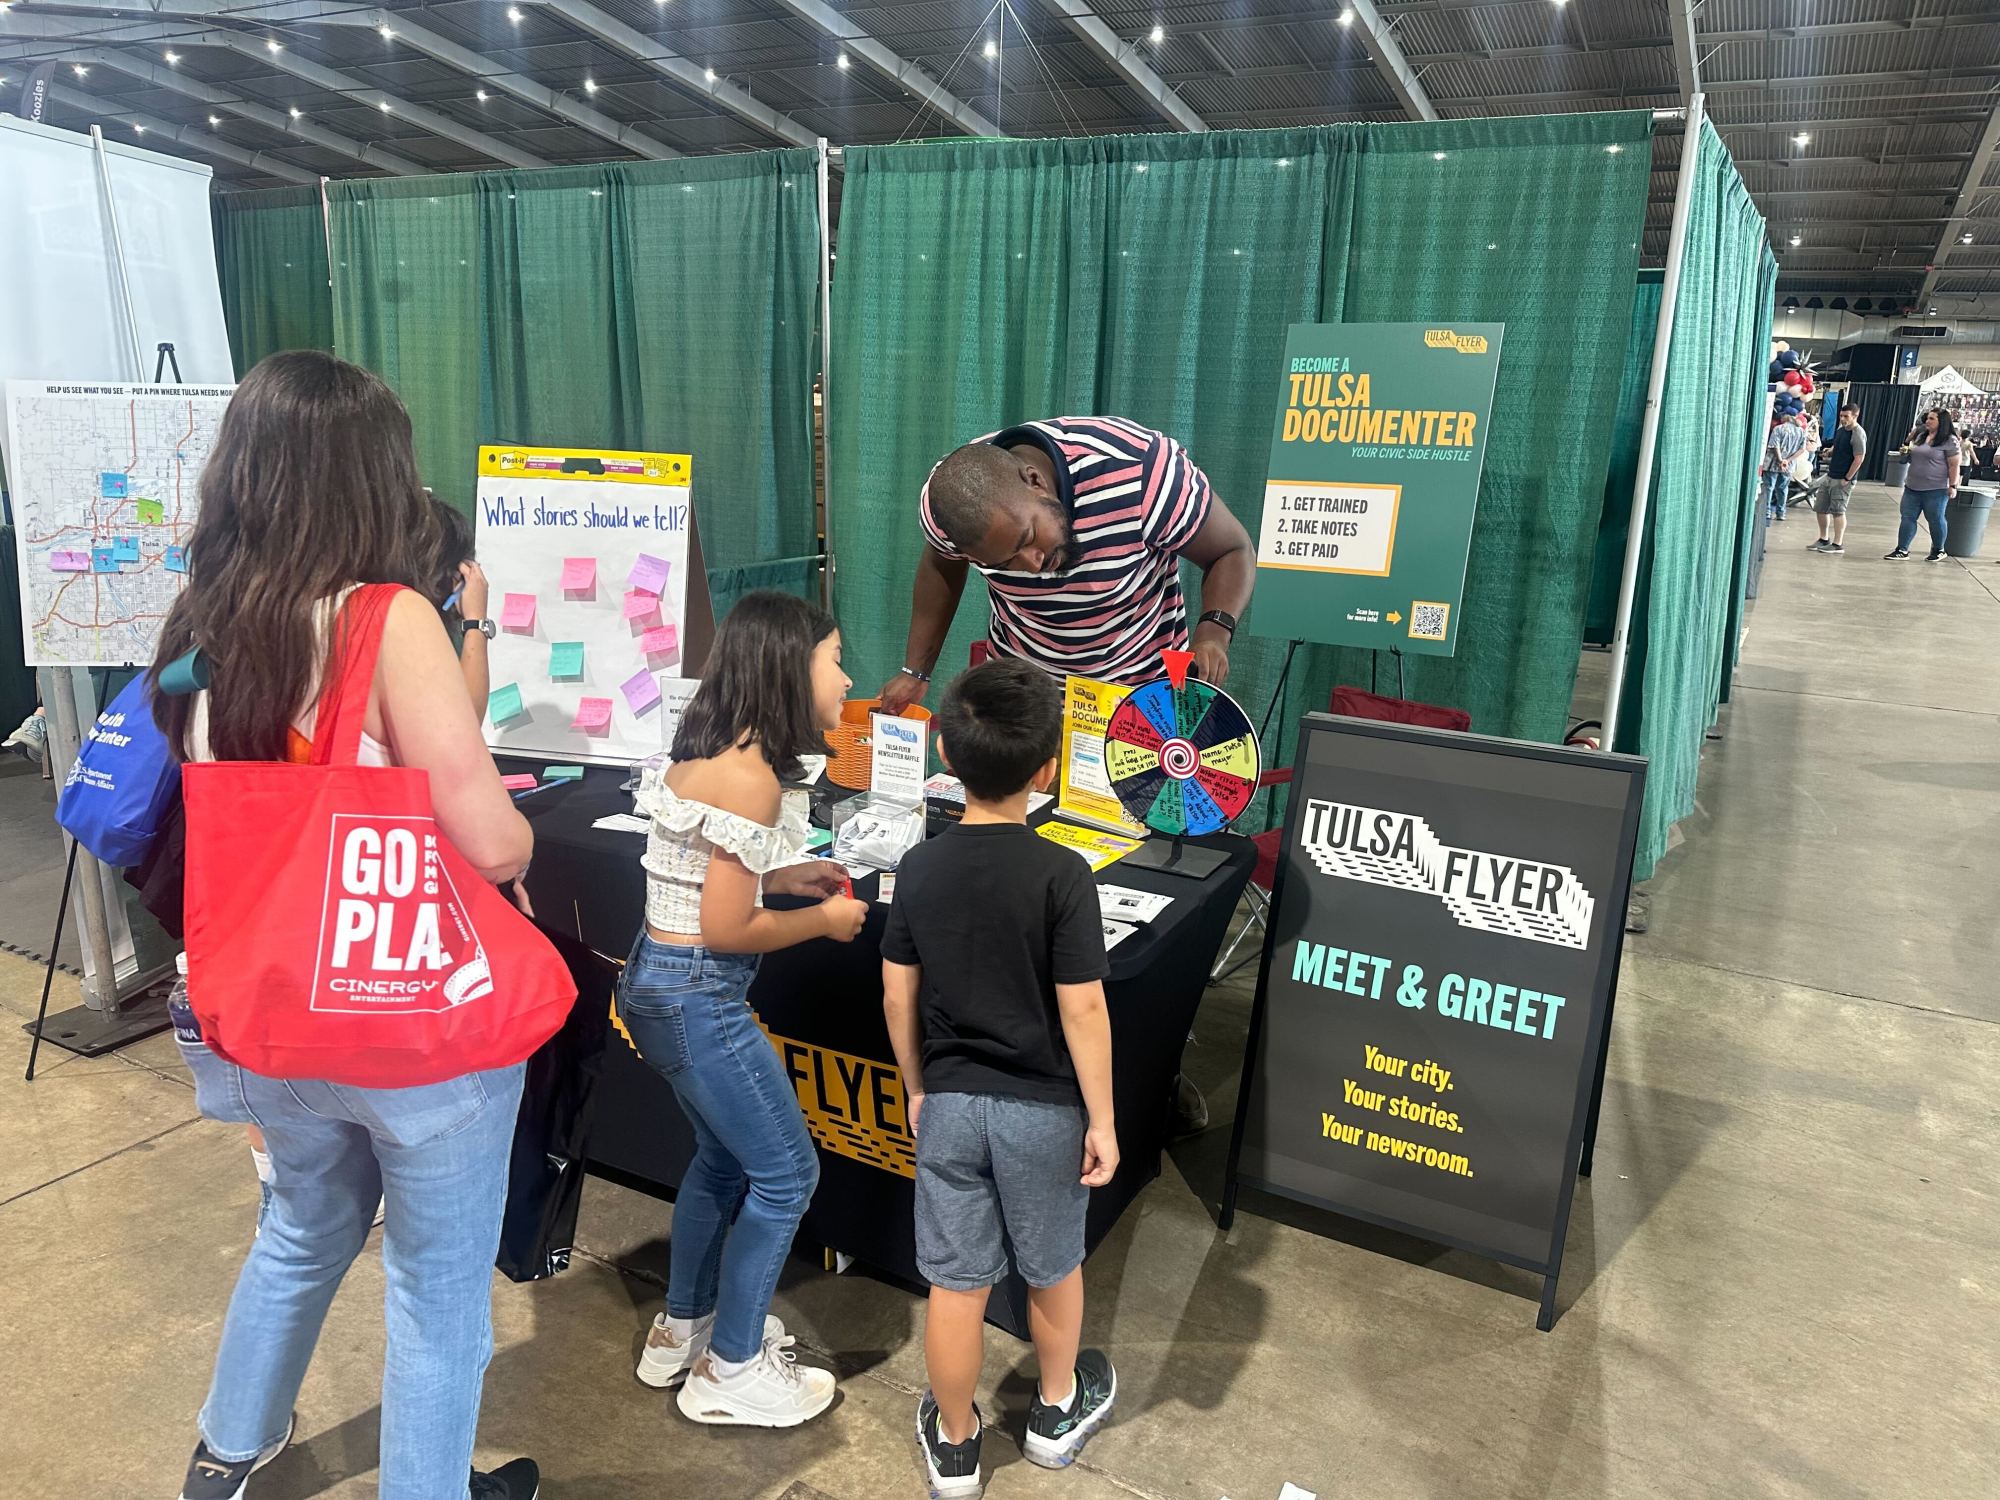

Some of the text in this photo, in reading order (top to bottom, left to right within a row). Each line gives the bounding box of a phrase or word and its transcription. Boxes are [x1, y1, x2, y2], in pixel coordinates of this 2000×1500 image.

[1426, 331, 1482, 347] TULSA FLYER
[1291, 357, 1350, 373] BECOME A
[46, 386, 61, 394] HELP
[83, 387, 99, 395] WHAT
[100, 387, 112, 395] YOU
[201, 389, 219, 397] NEEDS
[1289, 373, 1370, 408] TULSA
[1282, 409, 1477, 446] DOCUMENTER
[1351, 447, 1472, 461] YOUR CIVIC SIDE HUSTLE
[482, 496, 688, 531] What stories should we tell?
[1280, 496, 1368, 514] 1. GET TRAINED
[1277, 519, 1358, 537] 2. TAKE NOTES
[1274, 541, 1339, 559] 3. GET PAID
[1072, 700, 1098, 713] TULSA
[1071, 722, 1083, 730] JOIN
[878, 750, 920, 763] NEWSLETTER RAFFLE
[885, 743, 911, 753] TULSA FLYER
[1201, 749, 1222, 760] Name
[342, 827, 417, 898] GO
[1309, 802, 1565, 914] TULSA FLYER
[330, 978, 439, 994] CINERGY
[1291, 940, 1566, 1040] MEET & GREET
[349, 995, 417, 1003] ENTERTAINMENT
[1364, 1044, 1455, 1093] Your city.
[784, 1041, 915, 1139] FLYE
[1343, 1079, 1464, 1134] Your stories.
[1321, 1113, 1475, 1178] Your newsroom.
